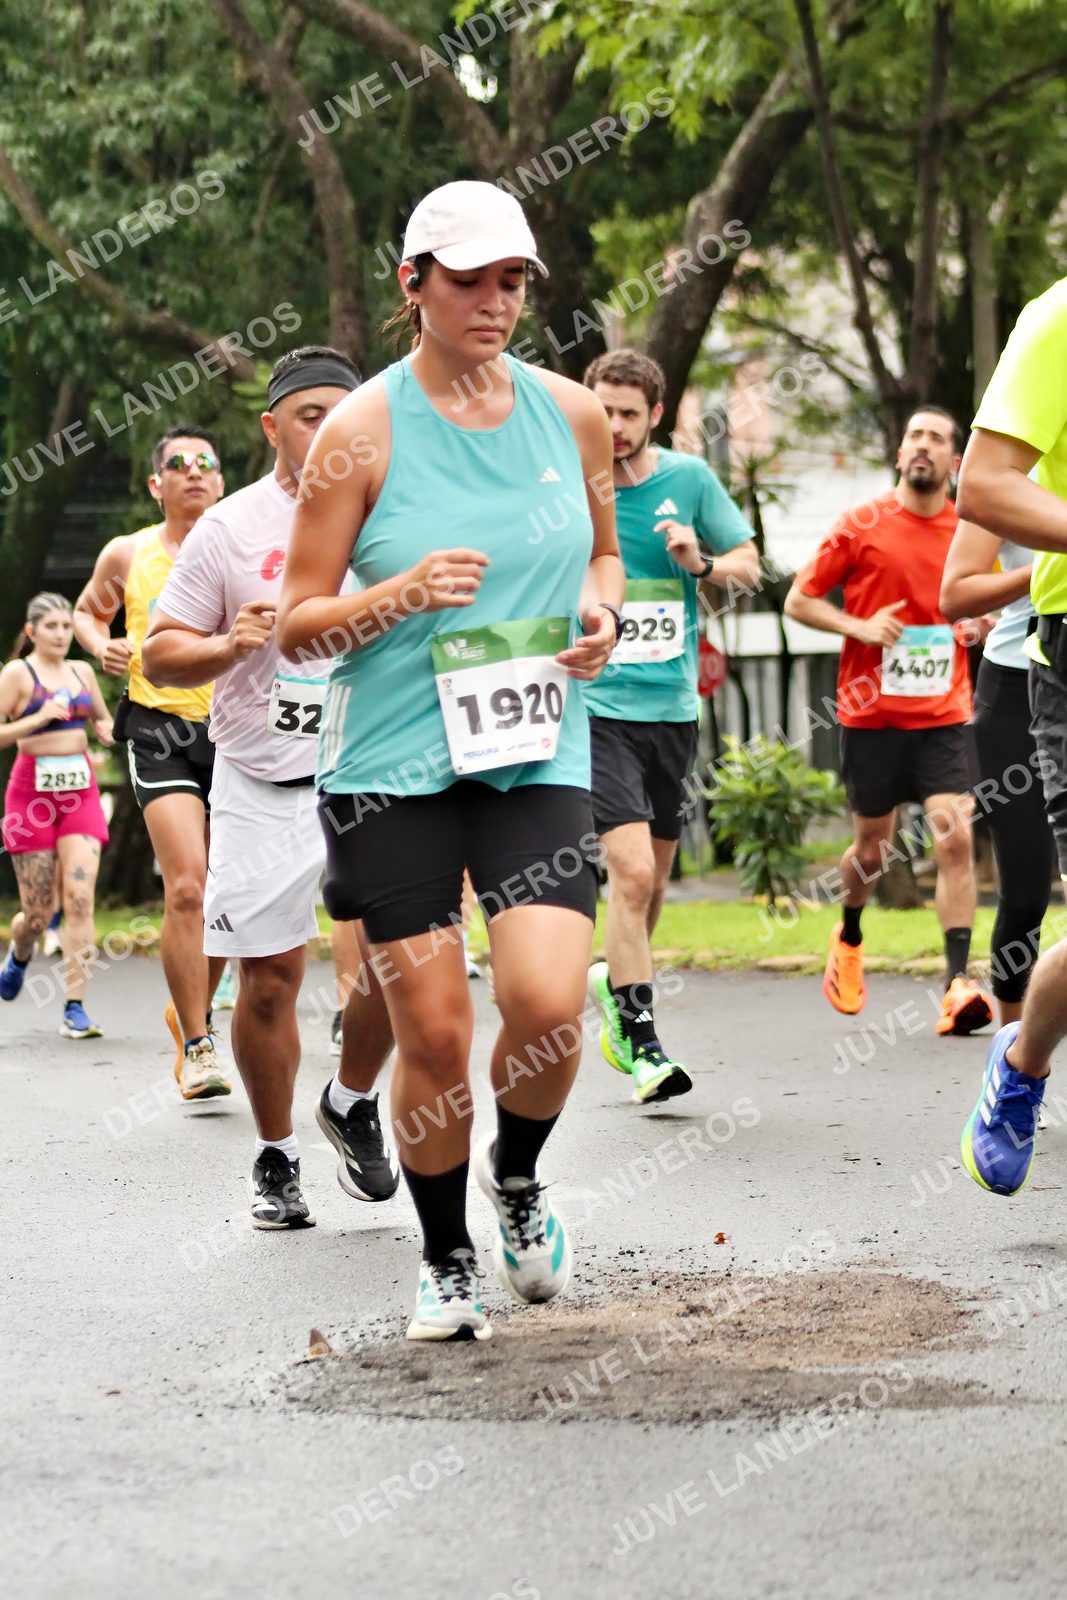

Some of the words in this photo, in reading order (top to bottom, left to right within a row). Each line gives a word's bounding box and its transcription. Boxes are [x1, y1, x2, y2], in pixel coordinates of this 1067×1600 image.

[622, 617, 677, 642] 929
[888, 658, 950, 679] 4407
[274, 699, 323, 735] 32
[456, 681, 563, 736] 1920
